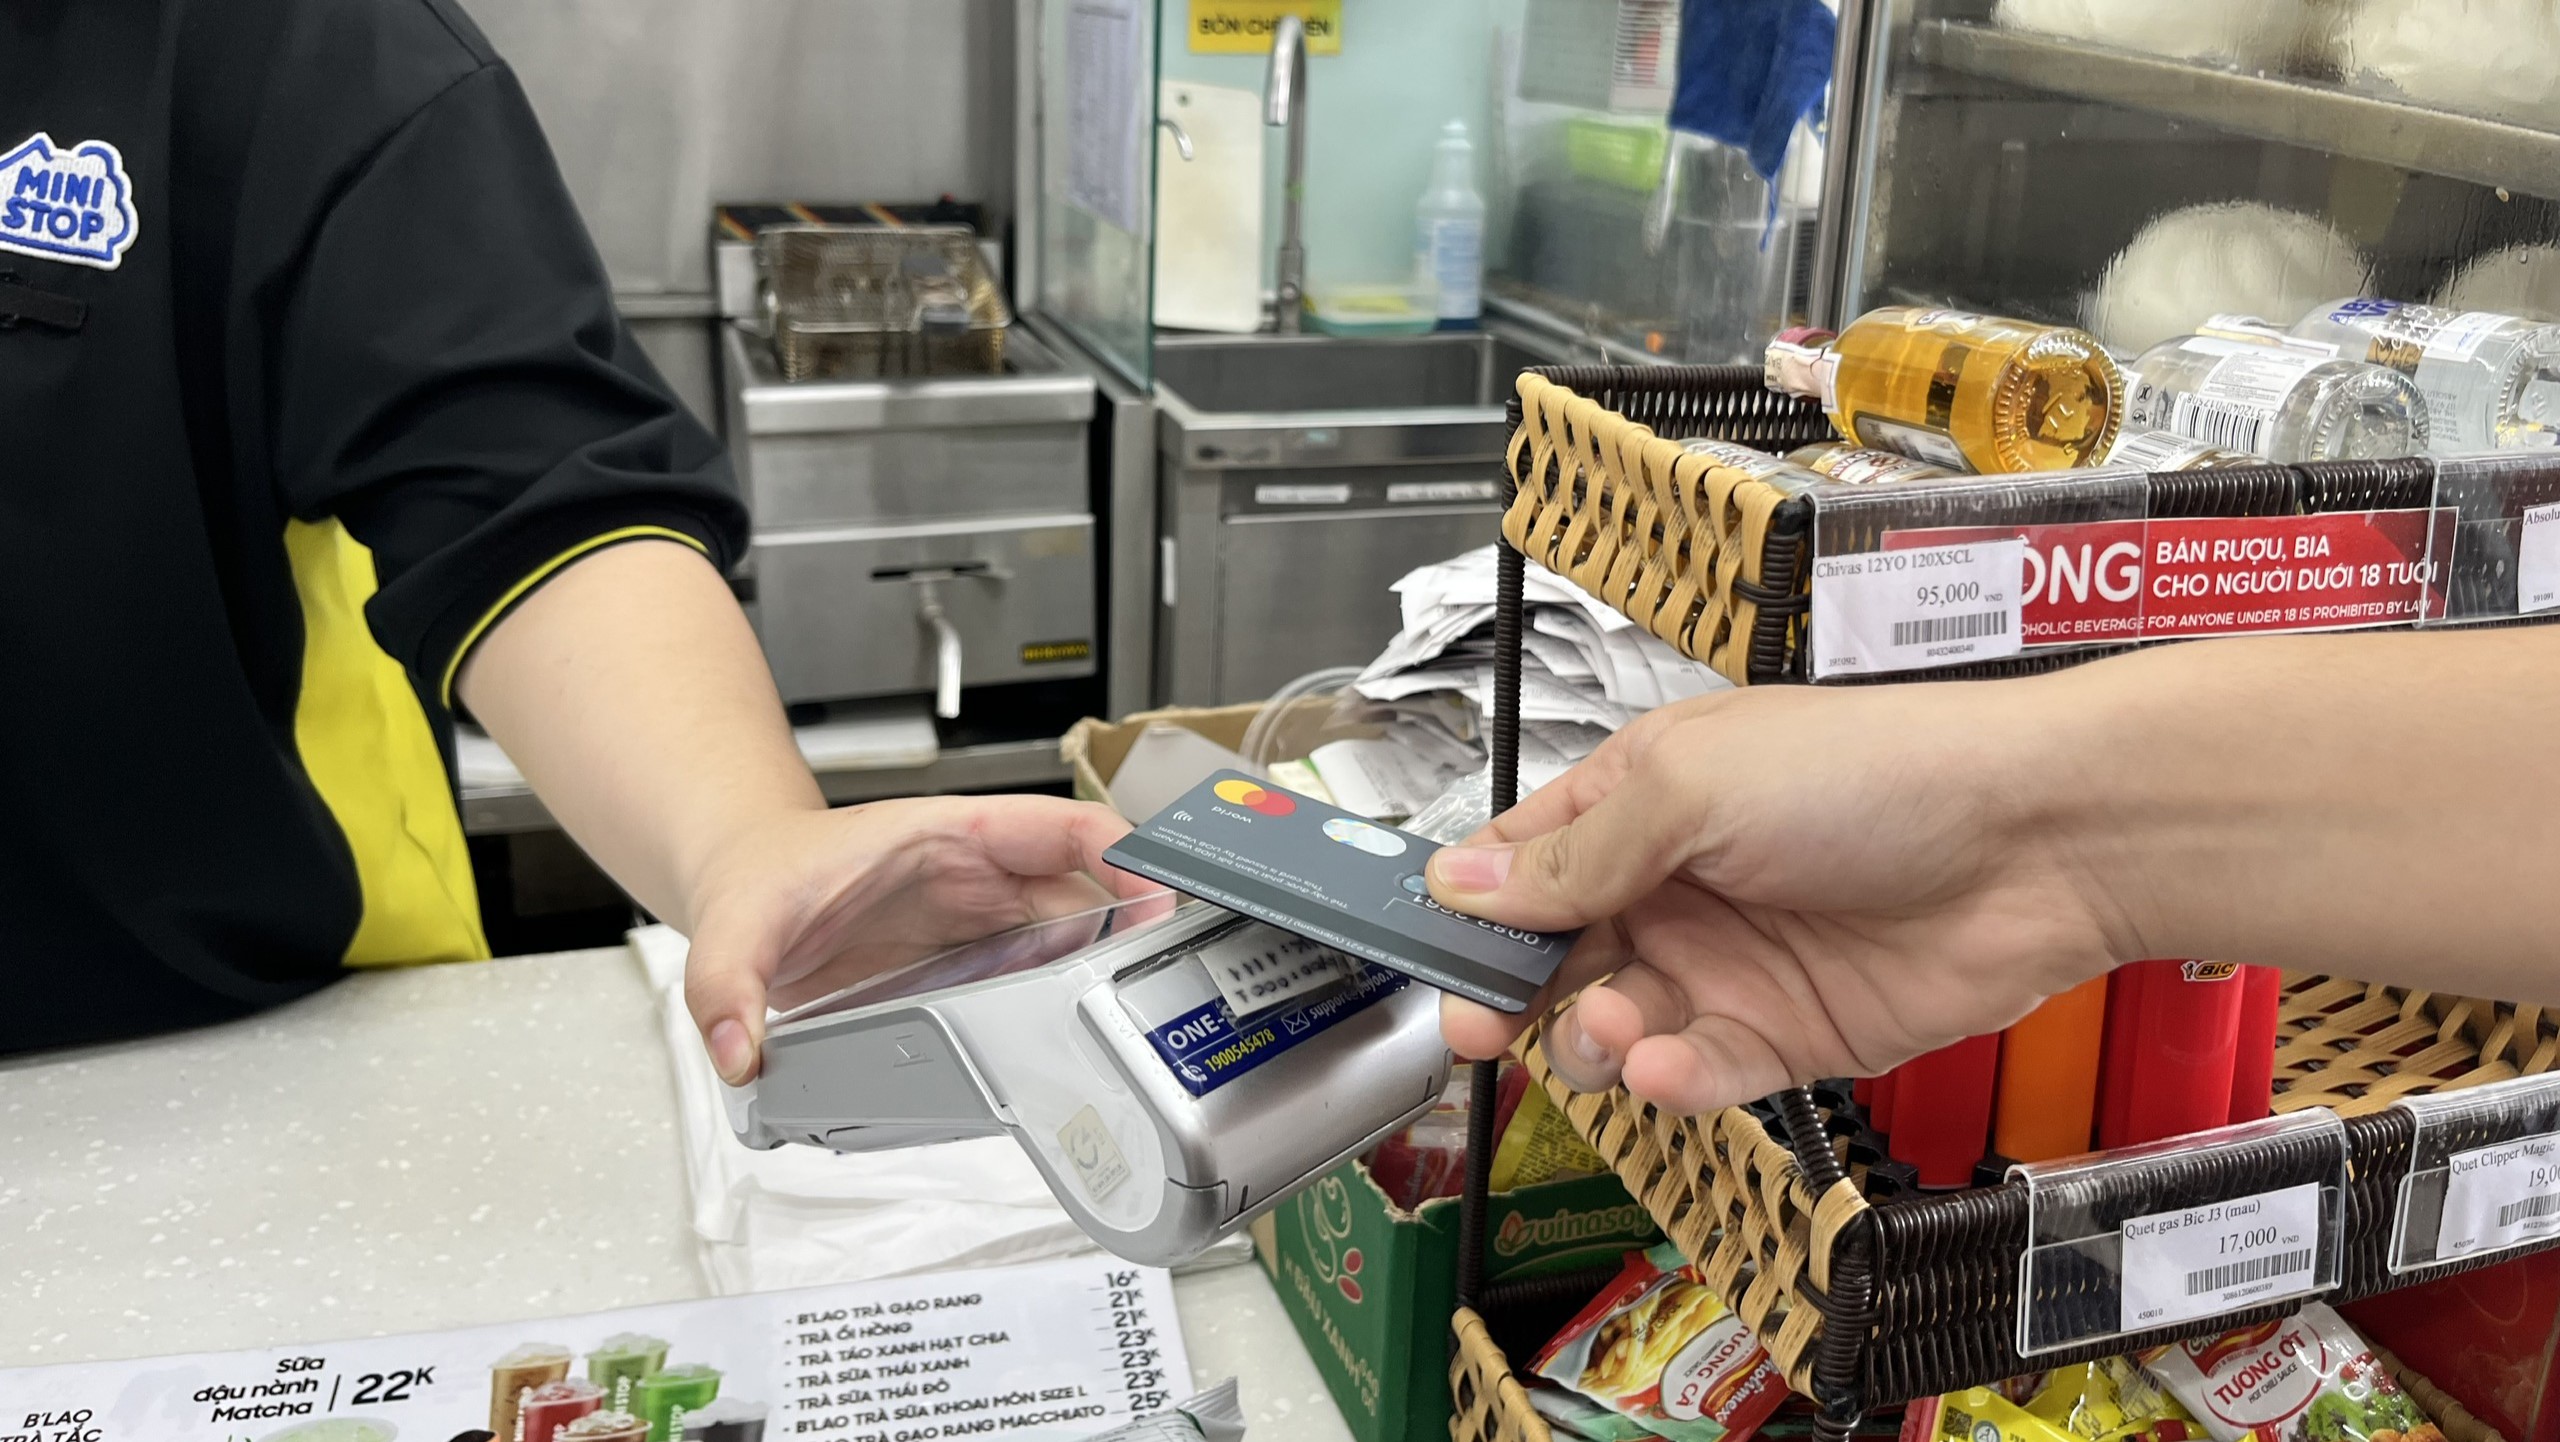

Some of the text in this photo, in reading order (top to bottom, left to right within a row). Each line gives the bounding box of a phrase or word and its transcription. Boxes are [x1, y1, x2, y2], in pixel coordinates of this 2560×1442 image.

[14, 166, 104, 209] MINI
[2, 197, 104, 241] STOP
[2525, 508, 2560, 526] Absolu
[1816, 549, 1974, 578] Chivas 12YO 120X5CL
[2156, 537, 2206, 565] BÁN
[2213, 535, 2287, 566] RƯỢU,
[2294, 535, 2330, 559] BIA
[1917, 581, 2003, 607] 95,000 VND
[2153, 573, 2209, 598] CHO
[2215, 566, 2291, 596] NGƯỜI
[2297, 562, 2354, 592] DƯỚI
[2359, 564, 2381, 588] 18
[2074, 616, 2145, 634] BEVERAGE
[2147, 615, 2176, 630] FOR
[2178, 611, 2234, 627] ANYONE
[2237, 608, 2280, 624] UNDER
[2284, 607, 2297, 621] 18
[2299, 607, 2310, 620] IS
[2312, 602, 2384, 620] PROHIBITED
[2387, 601, 2403, 616] BY
[2404, 599, 2432, 614] LAW
[1211, 805, 1252, 824] world
[2198, 963, 2234, 976] BIC
[1205, 1027, 1276, 1073] 1900545478
[2453, 1140, 2556, 1176] Quet Clipper Magic
[2125, 1199, 2261, 1240] Quet gas Bic J3 (mau)
[2218, 1226, 2300, 1254] 17,000 VND
[853, 1301, 884, 1319] TRÀ
[889, 1299, 930, 1317] GẠO
[933, 1293, 982, 1310] RANG
[1105, 1269, 1140, 1288] 16K
[797, 1328, 832, 1346] TRÀ
[860, 1321, 912, 1337] HỒNG
[1109, 1288, 1143, 1309] 21K
[2138, 1308, 2163, 1320] 450010
[798, 1308, 1148, 1367] TRÀ TÁO XANH HẠT CHIA 21K
[797, 1327, 1156, 1388] TRÀ SỮA THÁI XANH 23K
[193, 1377, 319, 1406] đậu nành
[351, 1365, 436, 1405] 22K
[798, 1393, 832, 1410] TRÀ
[837, 1388, 873, 1406] SỮA
[877, 1383, 918, 1401] THÁI
[1120, 1348, 1160, 1369] 23K
[854, 1408, 889, 1426] TRÀ
[894, 1404, 929, 1420] SỮA
[934, 1398, 988, 1416] KHOAI
[993, 1390, 1036, 1408] MÔN
[1040, 1386, 1075, 1402] SIZE
[1078, 1385, 1088, 1397] L
[1124, 1368, 1166, 1390] 23K
[1676, 1382, 1699, 1408] CÀ
[2214, 1350, 2282, 1406] TƯƠNG
[2248, 1362, 2299, 1404] HOT CHILI SAUCE
[211, 1400, 313, 1423] Matcha
[943, 1419, 995, 1437] RANG
[1000, 1404, 1106, 1430] MACCHIATO
[1129, 1389, 1171, 1411] 25K
